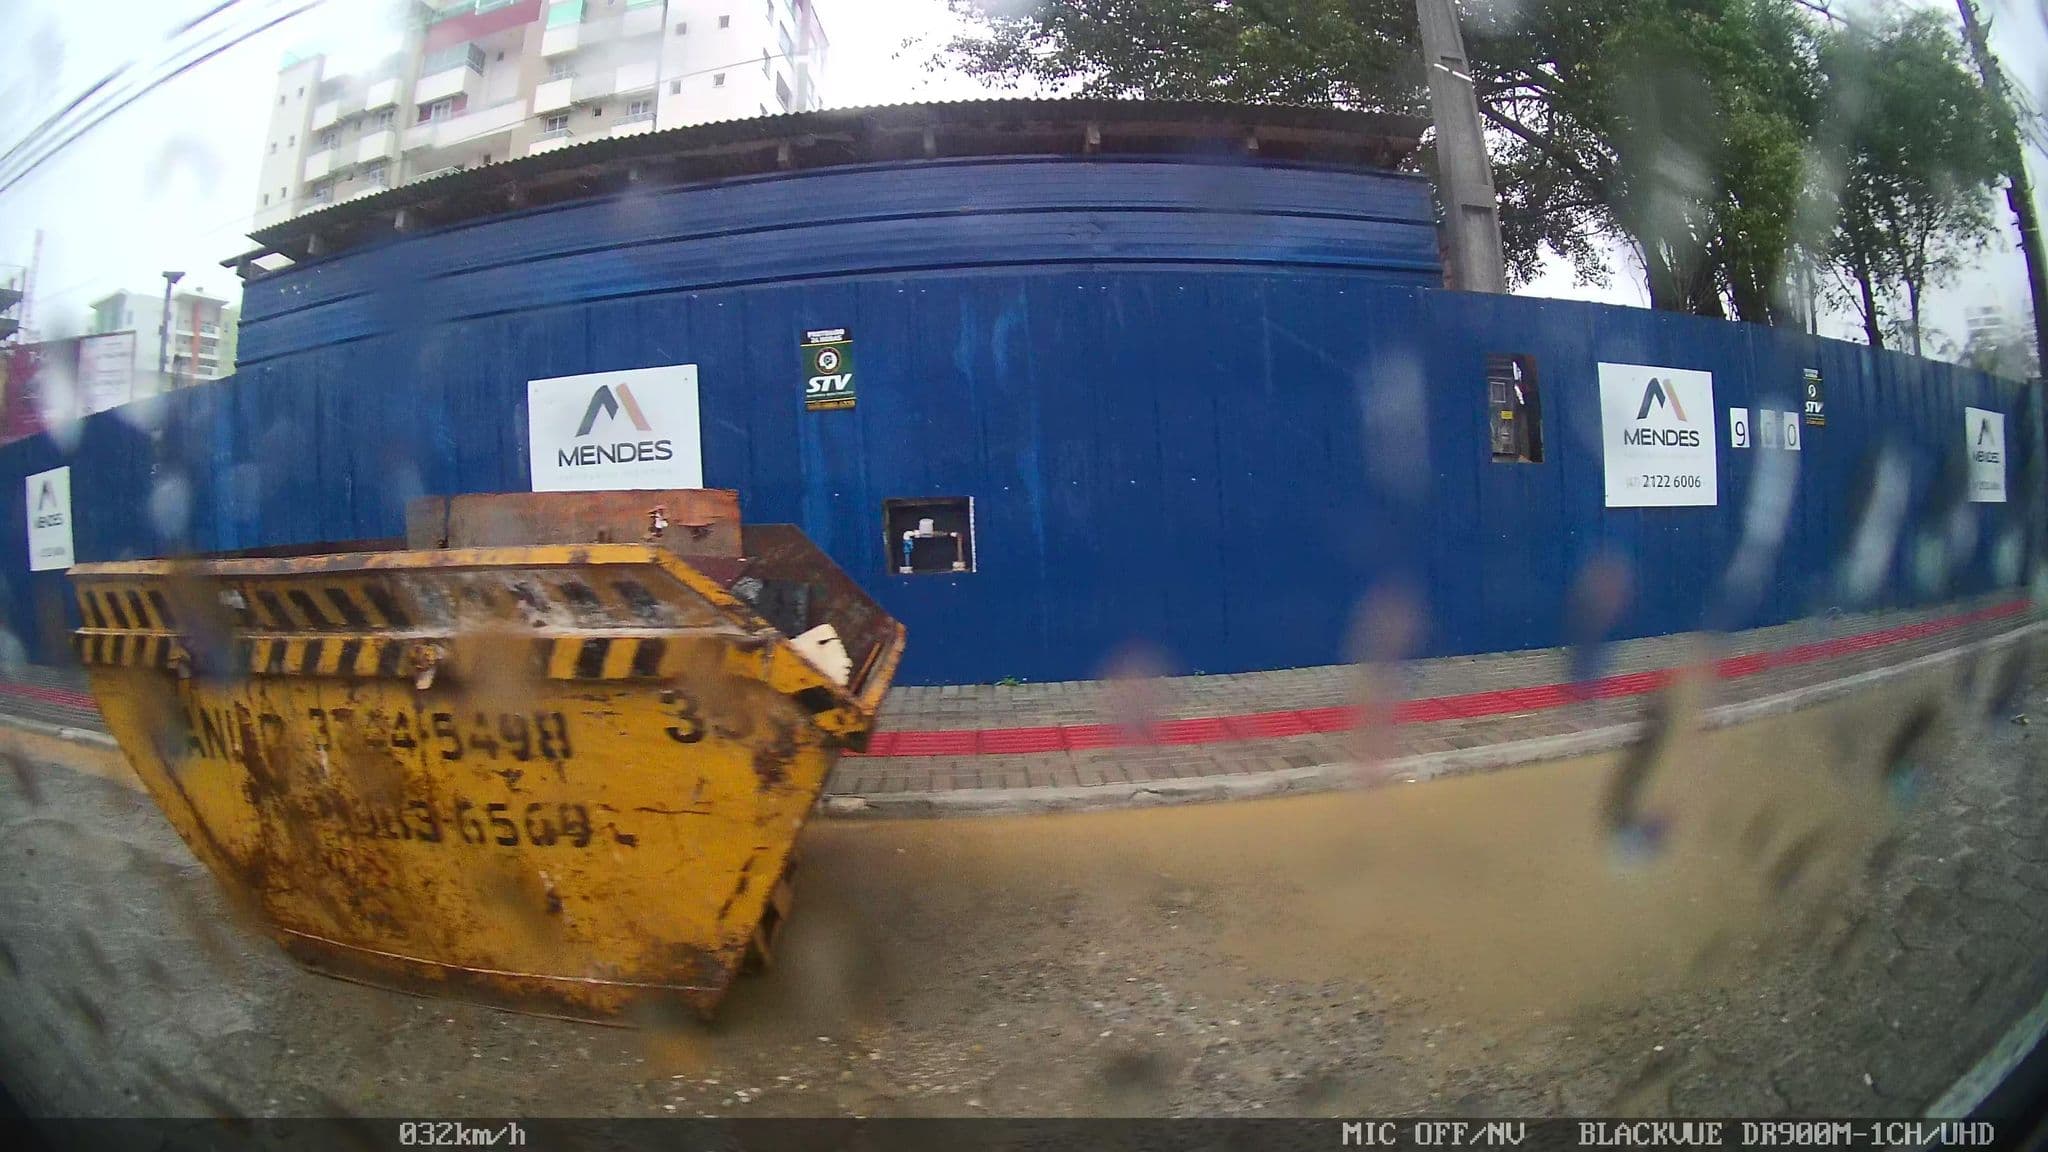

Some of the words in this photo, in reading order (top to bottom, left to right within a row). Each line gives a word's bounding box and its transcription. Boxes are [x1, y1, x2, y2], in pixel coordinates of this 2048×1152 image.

[806, 373, 853, 393] STV
[1805, 401, 1824, 413] STV
[1624, 428, 1700, 447] MENDES
[558, 440, 673, 467] MENDES
[1642, 474, 1671, 488] 2122
[1673, 474, 1702, 488] 6006
